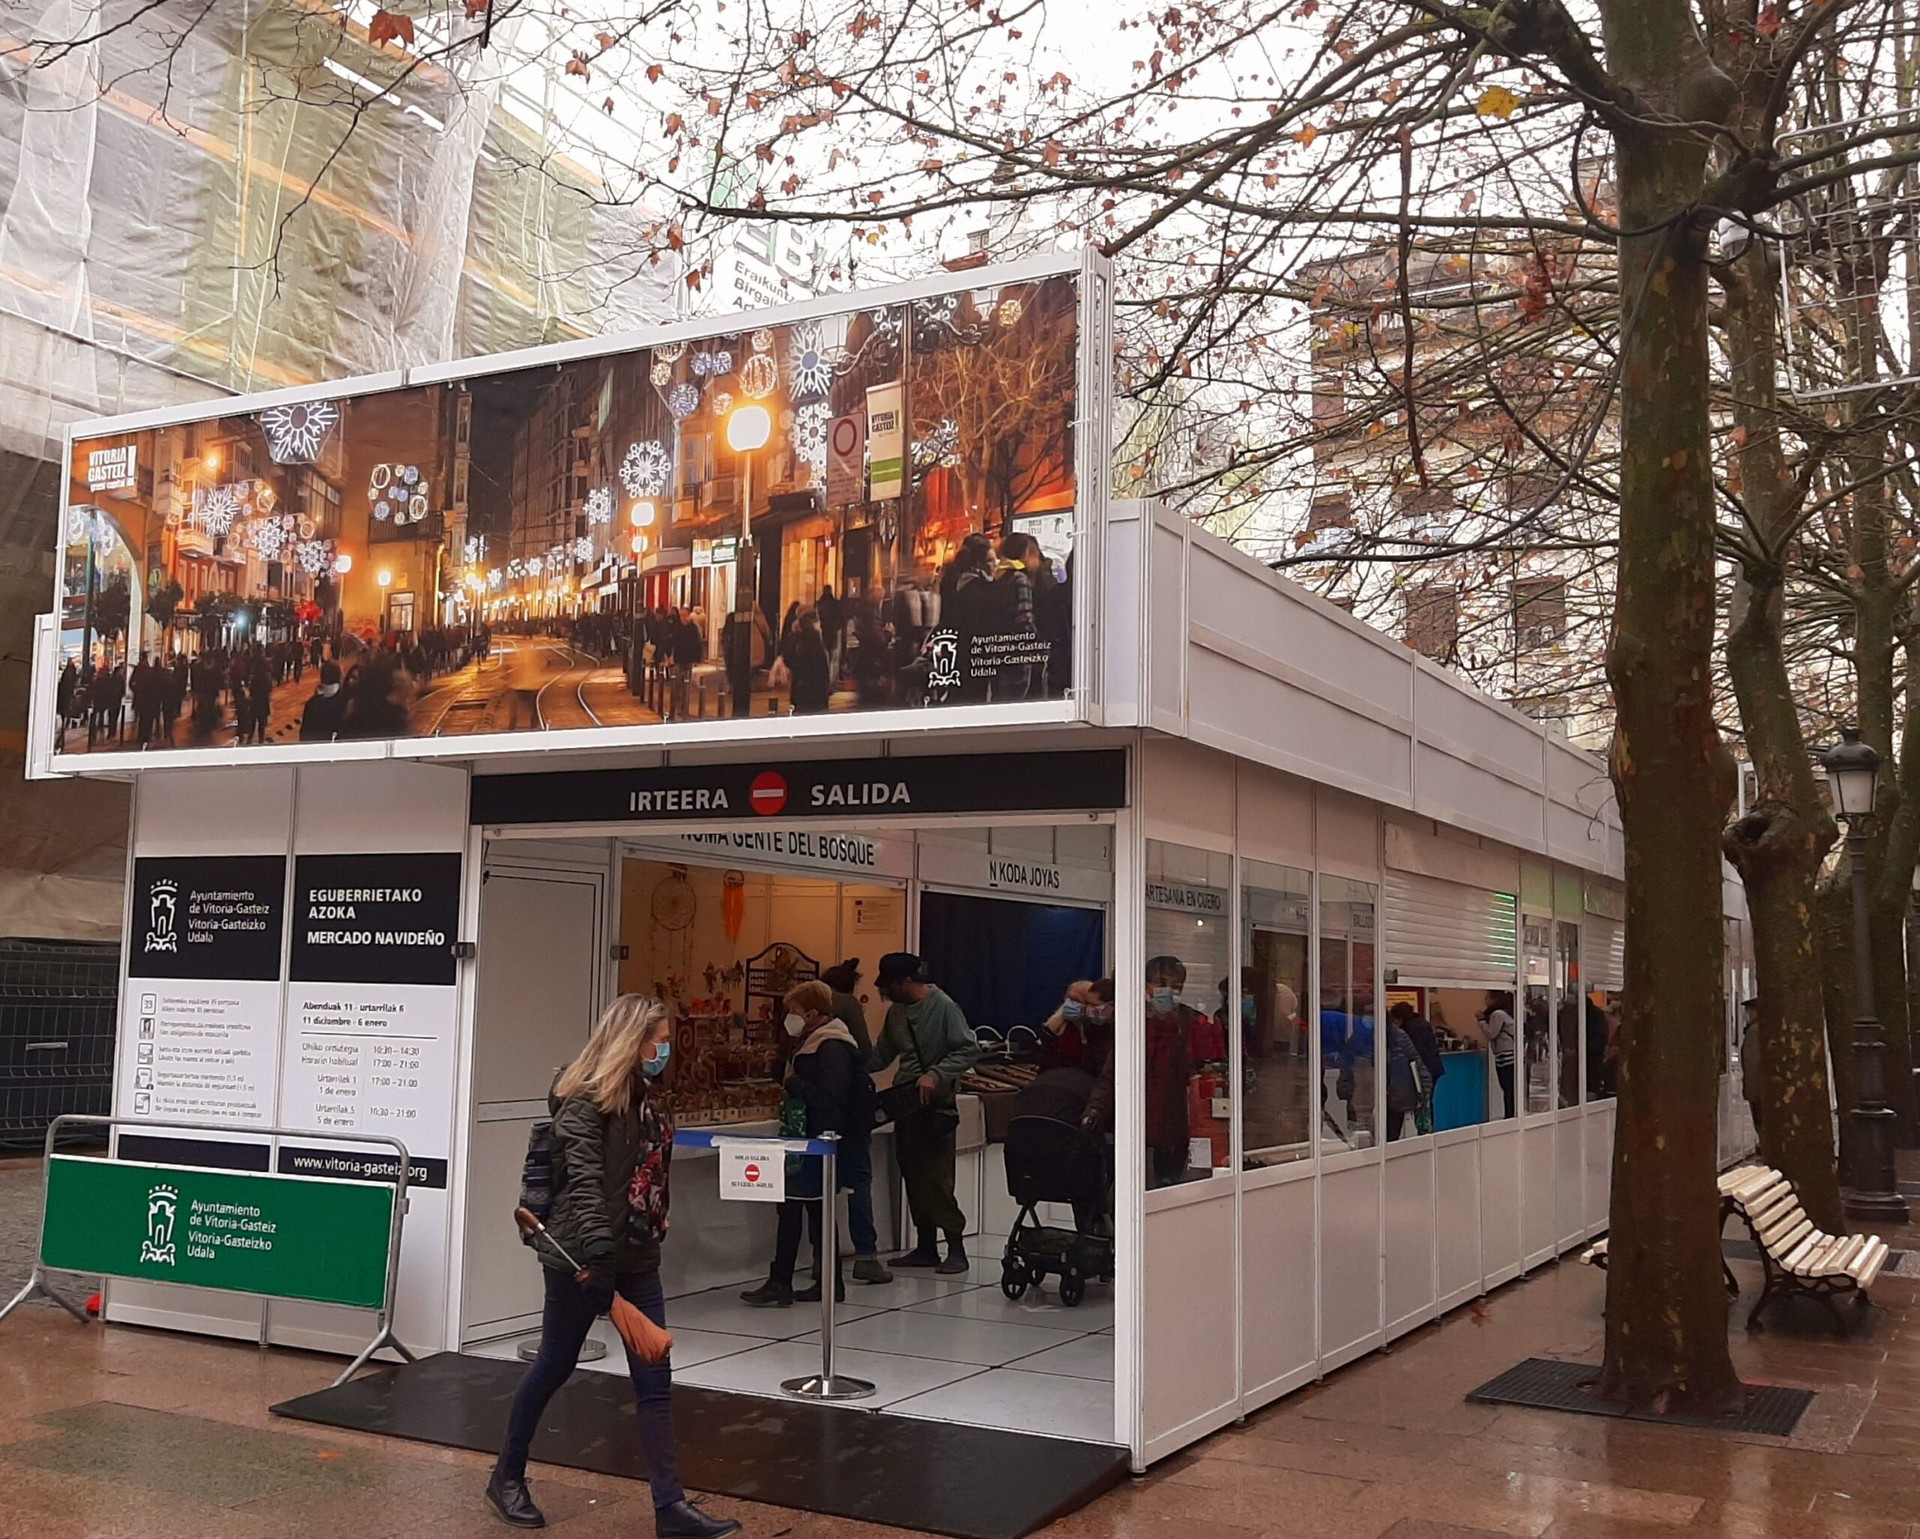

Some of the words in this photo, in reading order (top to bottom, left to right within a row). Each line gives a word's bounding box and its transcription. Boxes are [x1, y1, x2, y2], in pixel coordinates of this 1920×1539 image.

[734, 260, 795, 302] Eraikuntz
[732, 295, 755, 312] Ar
[971, 632, 1036, 646] Ayuntamiento
[970, 645, 982, 655] de
[984, 641, 1052, 654] Vitoria-Gasteiz
[970, 654, 1049, 667] Vitoria-Gasteizko
[970, 667, 997, 677] Udala
[629, 788, 729, 812] IRTEERA
[811, 782, 911, 806] SALIDA
[788, 831, 816, 857] DEL
[819, 836, 875, 866] BOSQUE
[999, 862, 1028, 885] KODA
[1029, 867, 1060, 889] JOYAS
[190, 890, 255, 904] Ayuntamiento
[309, 888, 423, 902] EGUBERRIETAKO
[1186, 890, 1196, 907] EN
[1197, 892, 1221, 910] CUERO
[189, 902, 201, 914] de
[202, 903, 270, 914] Vitoria-Gasteiz
[308, 906, 356, 919] AZOKA
[188, 918, 267, 930] Vitoria-Gasteizko
[187, 931, 214, 943] Udala
[307, 931, 372, 945] MERCADO
[374, 929, 446, 946] NAVIDEÑO
[302, 1001, 342, 1012] Abenduak
[344, 1003, 353, 1012] 11
[359, 1003, 398, 1013] urtarrilak
[302, 1016, 311, 1024] 11
[358, 1018, 363, 1026] 6
[364, 1019, 388, 1027] enero
[325, 1087, 334, 1095] de
[335, 1088, 356, 1096] enero
[190, 1199, 261, 1217] Ayuntamiento
[189, 1213, 202, 1226] de
[204, 1214, 277, 1233] Vitoria-Gasteiz
[188, 1230, 272, 1251] Vitoria-Gasteizko
[187, 1244, 215, 1259] Udala
